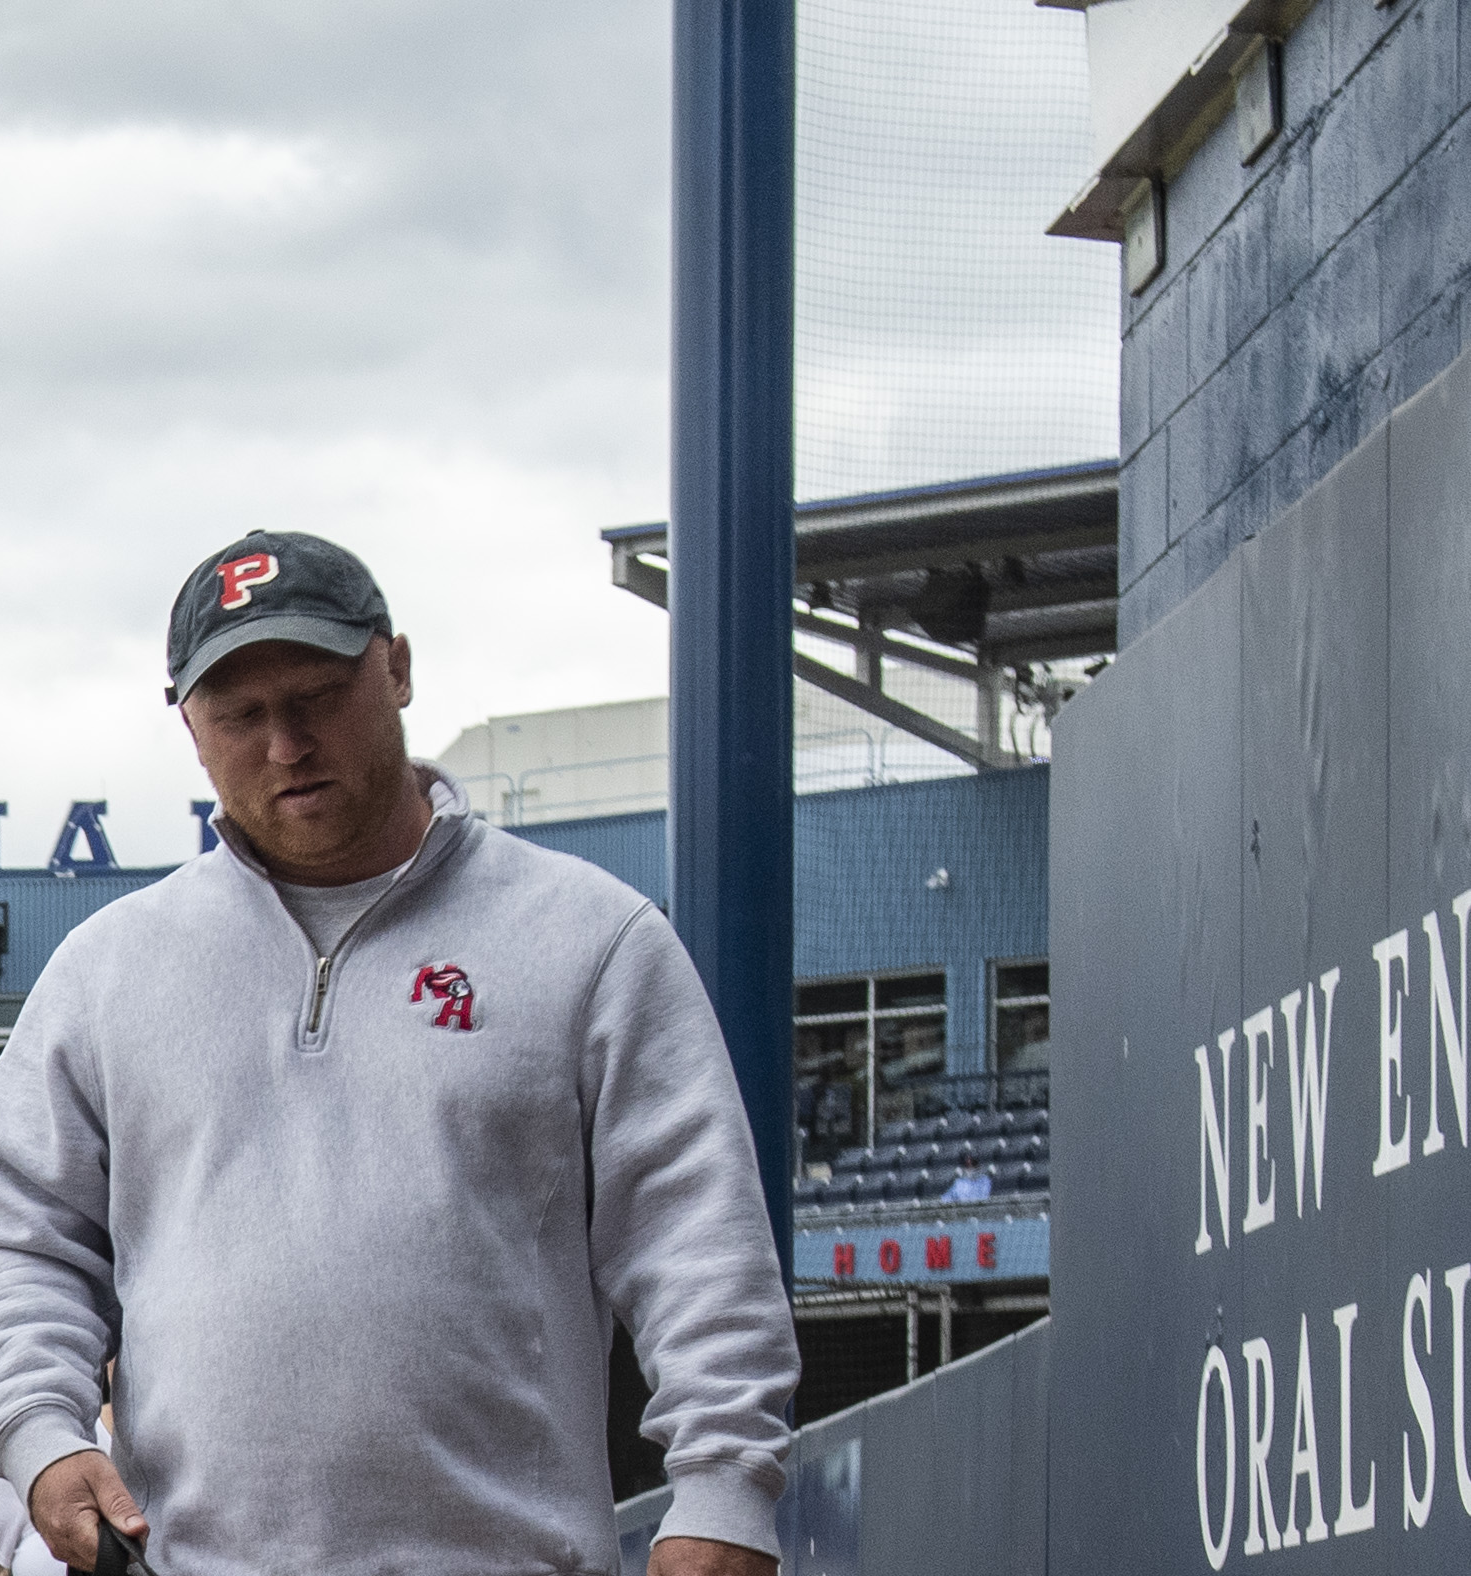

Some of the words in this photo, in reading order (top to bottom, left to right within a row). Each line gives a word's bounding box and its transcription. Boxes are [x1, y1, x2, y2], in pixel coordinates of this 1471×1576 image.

[216, 552, 281, 611] P
[1194, 966, 1340, 1256] NEW
[834, 1232, 997, 1276] HOME
[1196, 1302, 1376, 1571] ORAL
